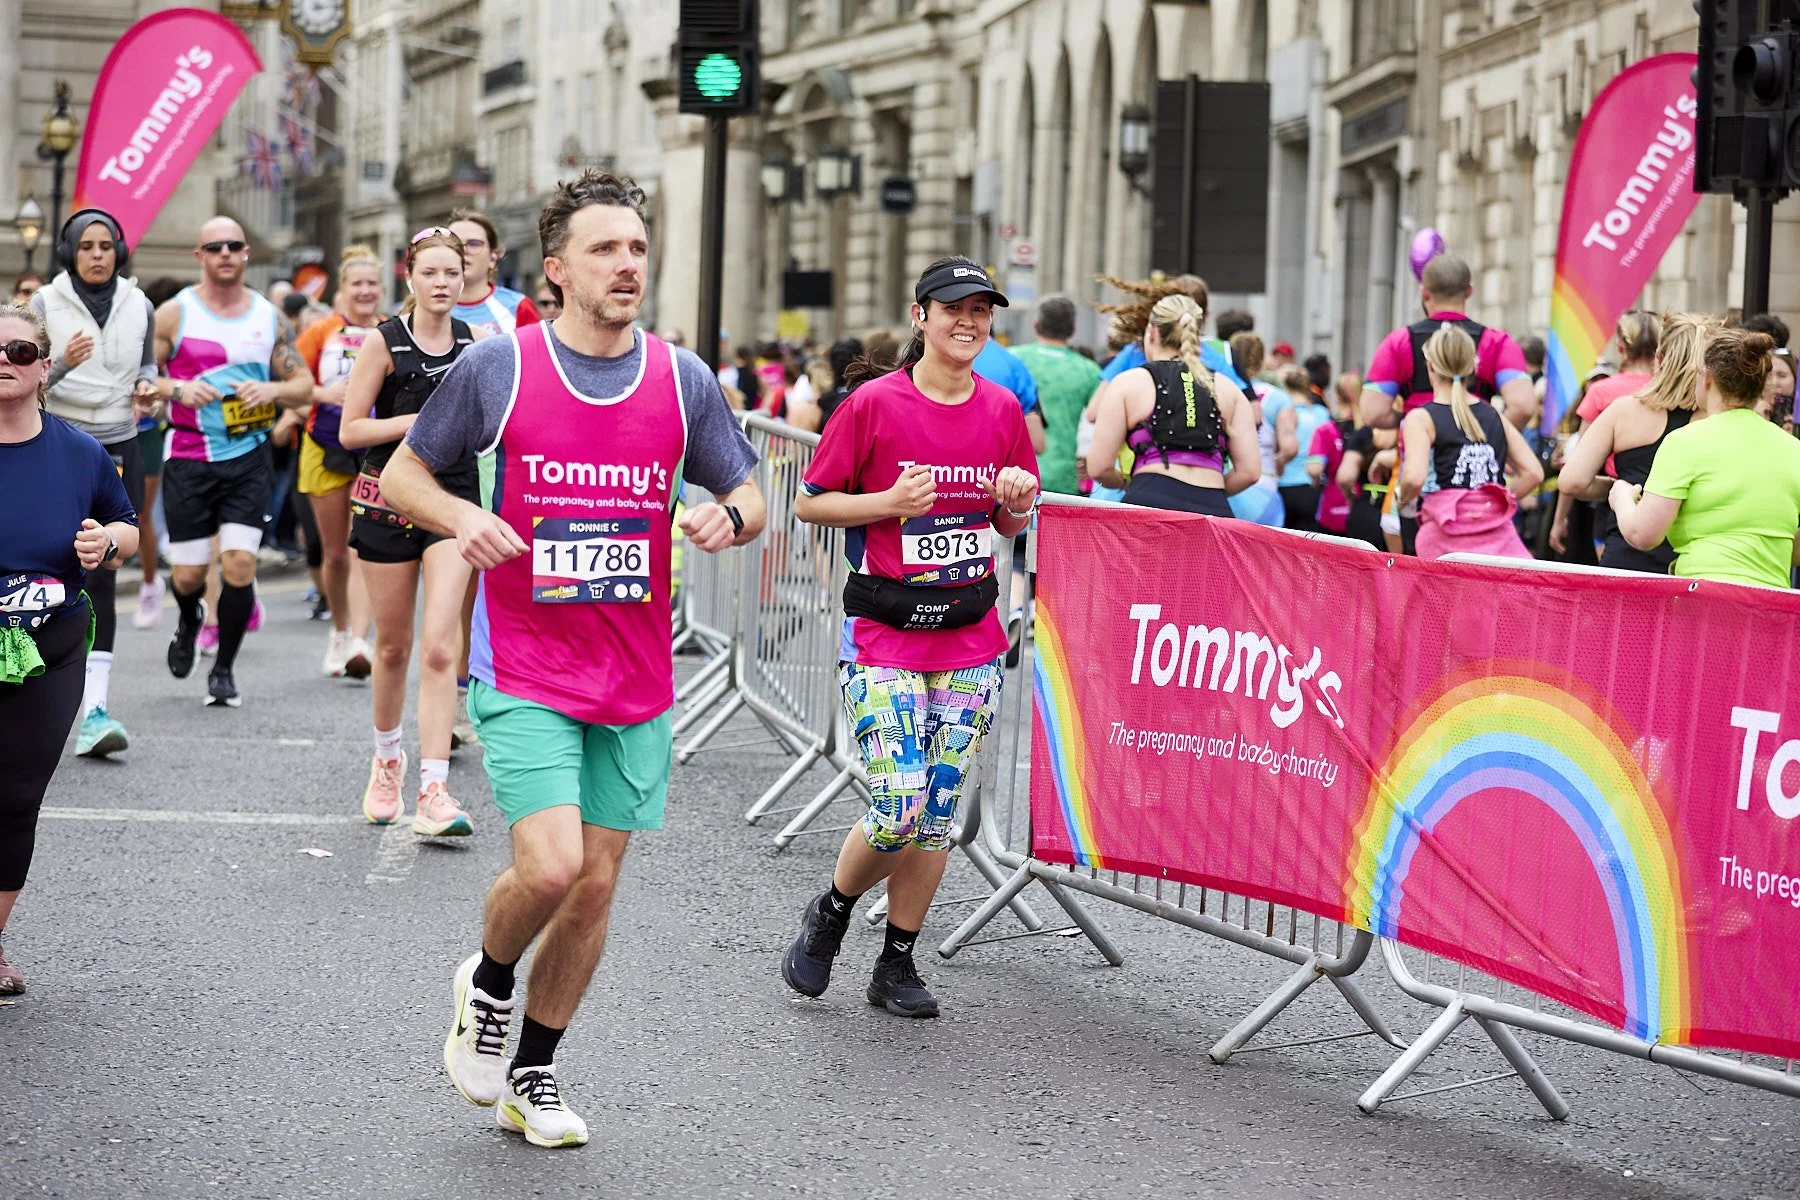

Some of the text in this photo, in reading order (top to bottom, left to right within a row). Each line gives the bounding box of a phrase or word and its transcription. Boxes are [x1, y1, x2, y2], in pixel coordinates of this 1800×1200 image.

[98, 45, 213, 185] Tommy's
[1582, 94, 1697, 250] Tommy's
[521, 454, 667, 496] Tommy's
[897, 460, 997, 489] Tmmy's
[523, 494, 665, 512] The pregnancy and baby charity
[964, 491, 981, 500] baby
[569, 523, 620, 533] RONNIE C
[934, 517, 965, 526] SANDIE
[544, 544, 642, 572] 11786
[917, 532, 979, 561] 8973
[7, 574, 28, 588] JULIE
[910, 613, 944, 623] RESS
[916, 604, 950, 613] COMP
[1129, 603, 1344, 729] Tommy's
[1108, 721, 1135, 747] The
[1137, 728, 1205, 760] pregnancy
[1207, 732, 1236, 759] and
[1719, 855, 1753, 891] The
